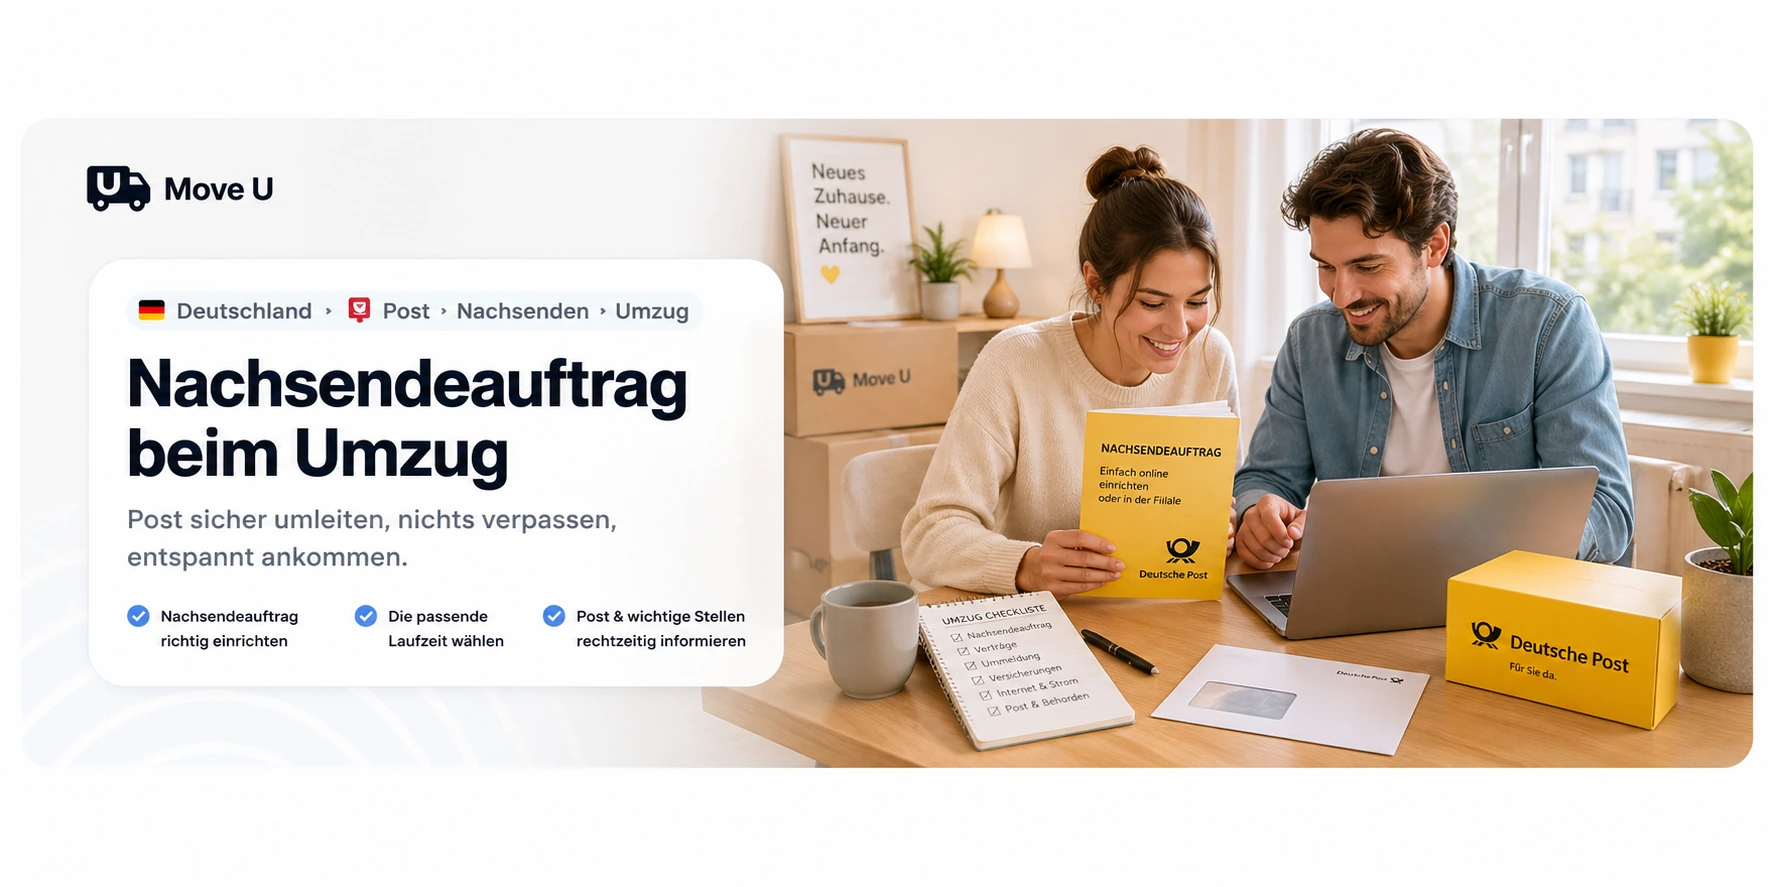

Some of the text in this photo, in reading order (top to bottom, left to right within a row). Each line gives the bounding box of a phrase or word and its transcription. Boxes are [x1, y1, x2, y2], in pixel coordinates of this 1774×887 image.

[812, 164, 865, 180] Neues
[815, 188, 890, 205] Zuhause.
[817, 214, 867, 229] Neuer
[819, 238, 884, 257] Anfang.
[853, 370, 910, 387] Move U
[1102, 443, 1221, 457] NACHSENDEAUFTRAG
[1099, 466, 1168, 478] Einfach online
[1099, 480, 1148, 490] einrichten
[1099, 493, 1121, 502] oder
[1124, 495, 1132, 503] in
[1135, 495, 1151, 504] der
[1140, 569, 1207, 579] Deutsche Post
[942, 605, 1046, 624] UMZUG CHECKLISTE
[967, 623, 1052, 639] Nachsendeauftrag
[981, 654, 1040, 667] Ummeldung
[1511, 635, 1629, 673] Deutsche Post
[989, 666, 1062, 683] Versicherungen
[1510, 662, 1557, 680] Für Sie da.
[997, 678, 1078, 697] Internet & Strom
[1005, 702, 1028, 712] Post
[1031, 700, 1039, 708] &
